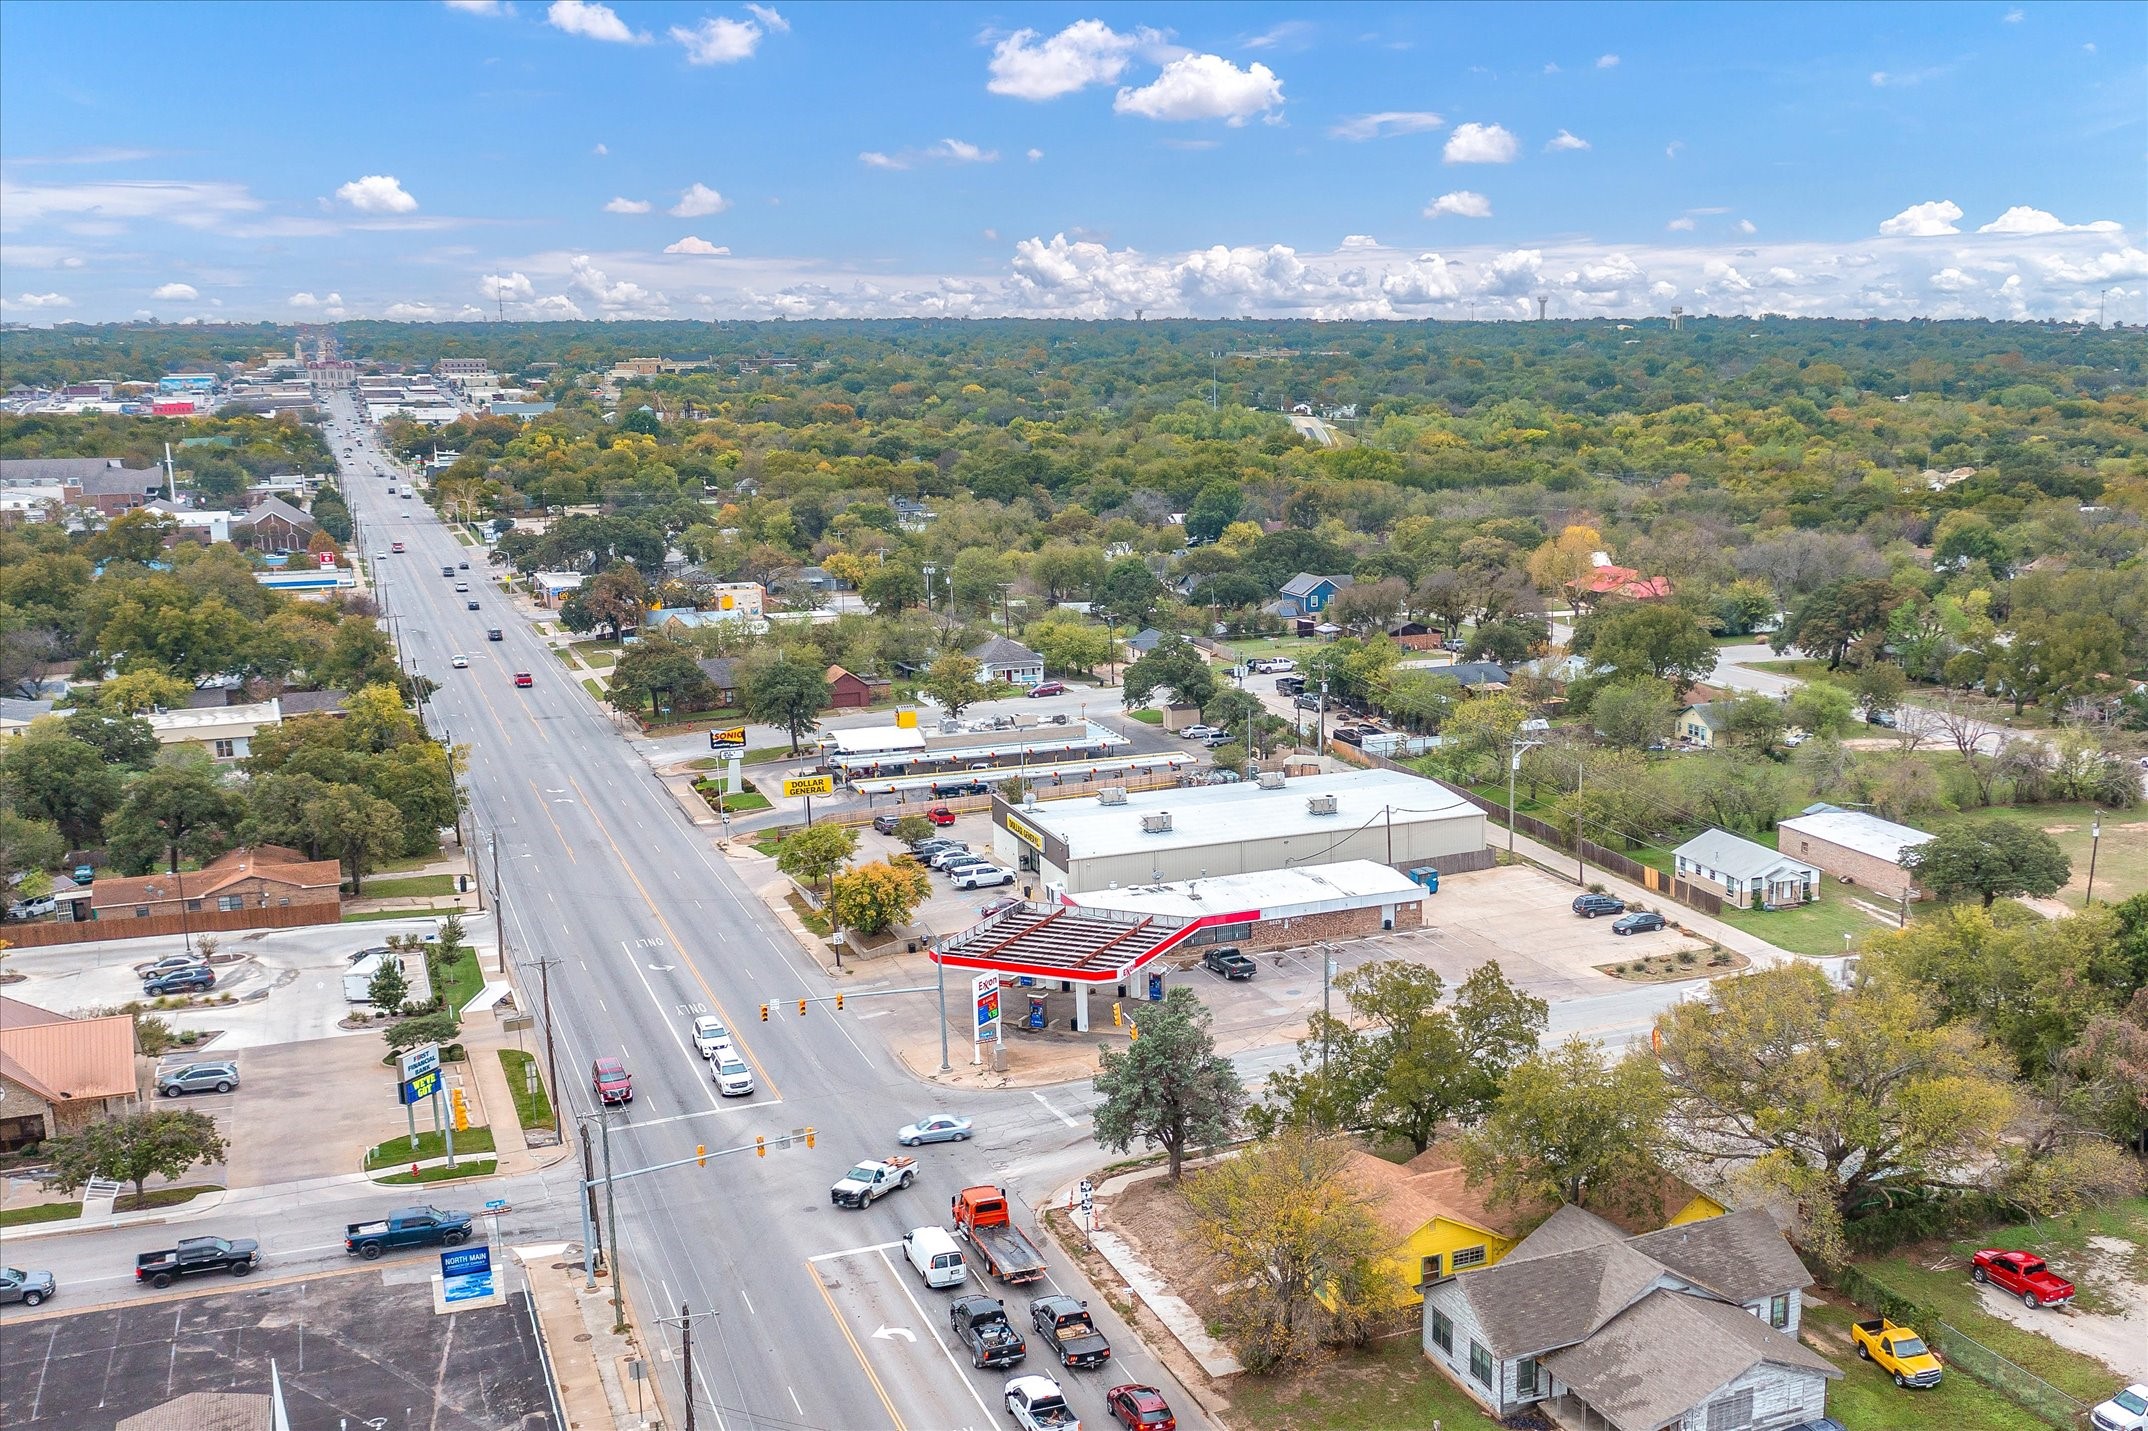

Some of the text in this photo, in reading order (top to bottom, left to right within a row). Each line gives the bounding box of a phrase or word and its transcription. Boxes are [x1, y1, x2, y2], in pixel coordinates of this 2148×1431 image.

[714, 731, 743, 741] SONIC
[790, 786, 827, 795] GENERAL
[791, 779, 824, 788] DOLLAR
[1008, 819, 1040, 848] DOLLAR GENERAL
[635, 937, 664, 949] ONLY
[978, 976, 998, 992] Exxon
[675, 1002, 707, 1016] ONLY
[413, 1050, 430, 1062] FIRST
[407, 1055, 437, 1072] FINANCIAL
[414, 1064, 431, 1076] BANK
[412, 1072, 436, 1090] WE'VE
[417, 1084, 433, 1098] GOT
[445, 1252, 487, 1266] NORTH MAIN
